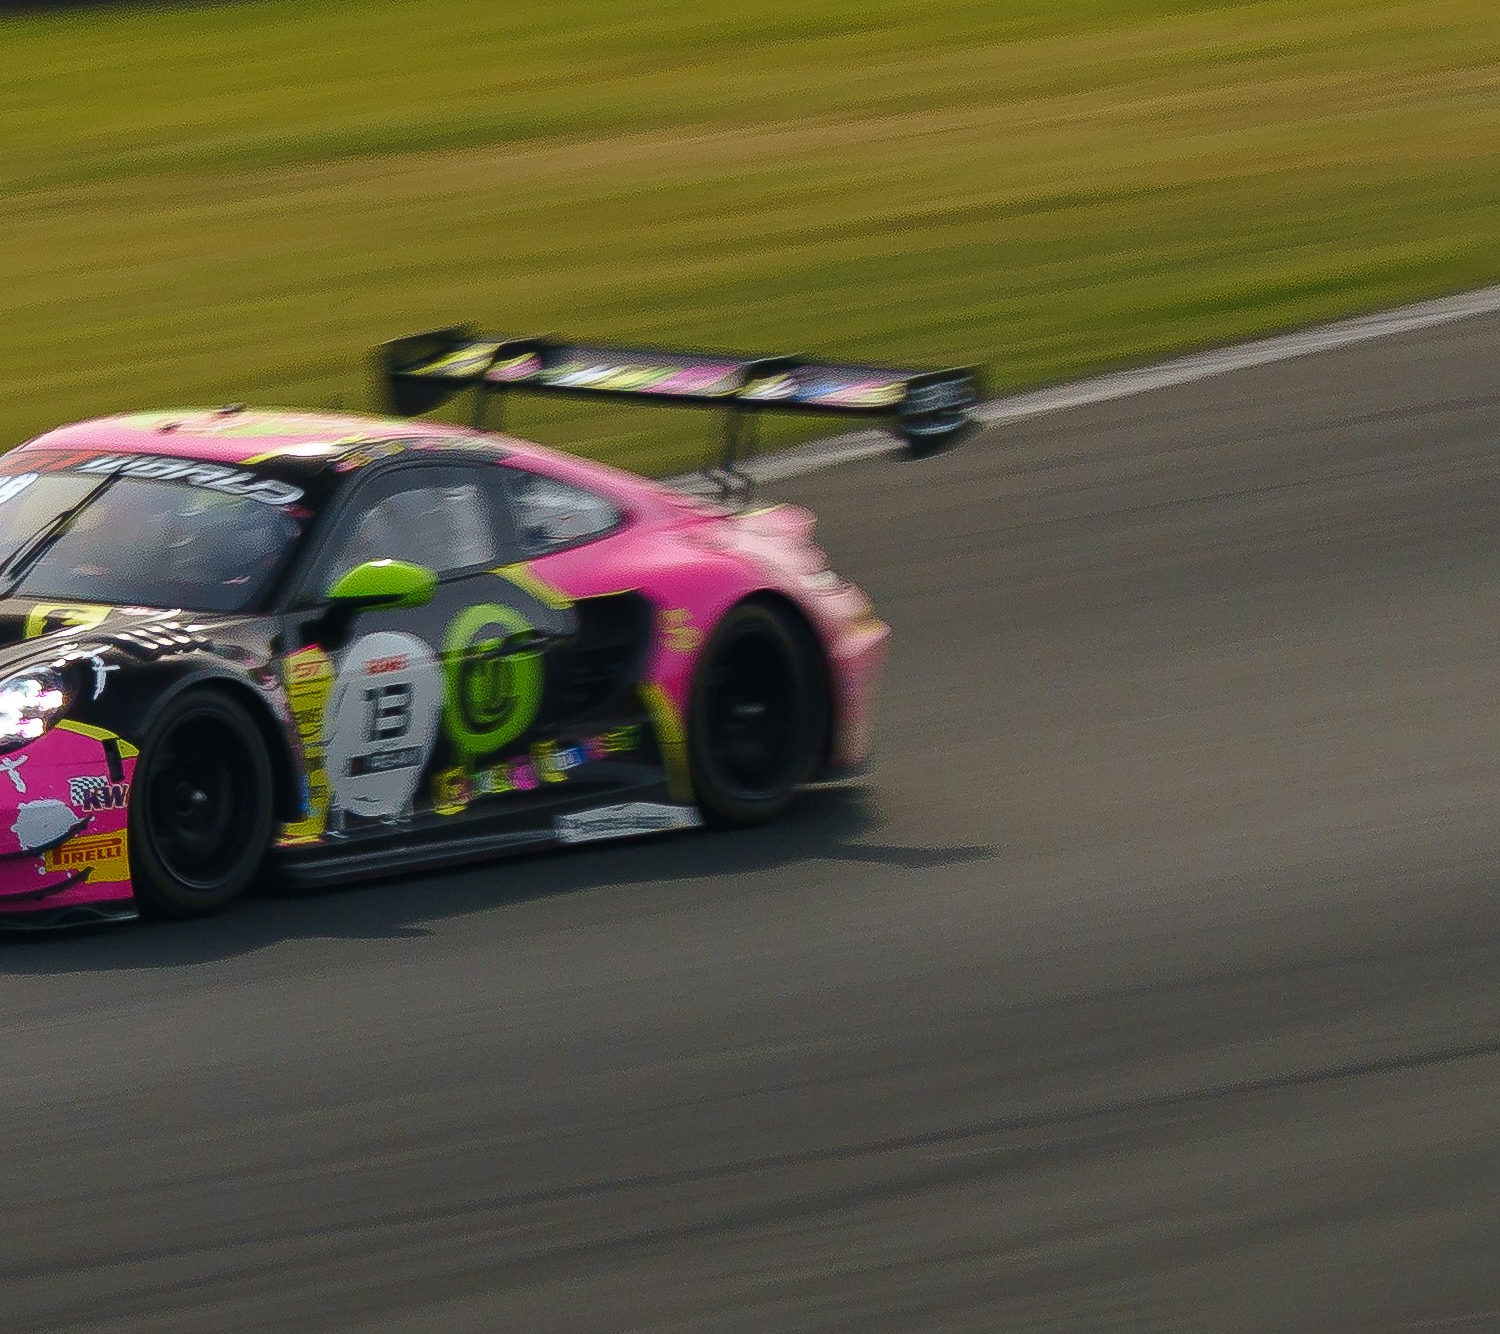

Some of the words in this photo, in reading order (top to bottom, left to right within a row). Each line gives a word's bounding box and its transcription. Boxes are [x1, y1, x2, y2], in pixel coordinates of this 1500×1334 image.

[362, 682, 414, 742] 13
[83, 784, 129, 811] KW
[52, 838, 122, 865] PIRELLI
